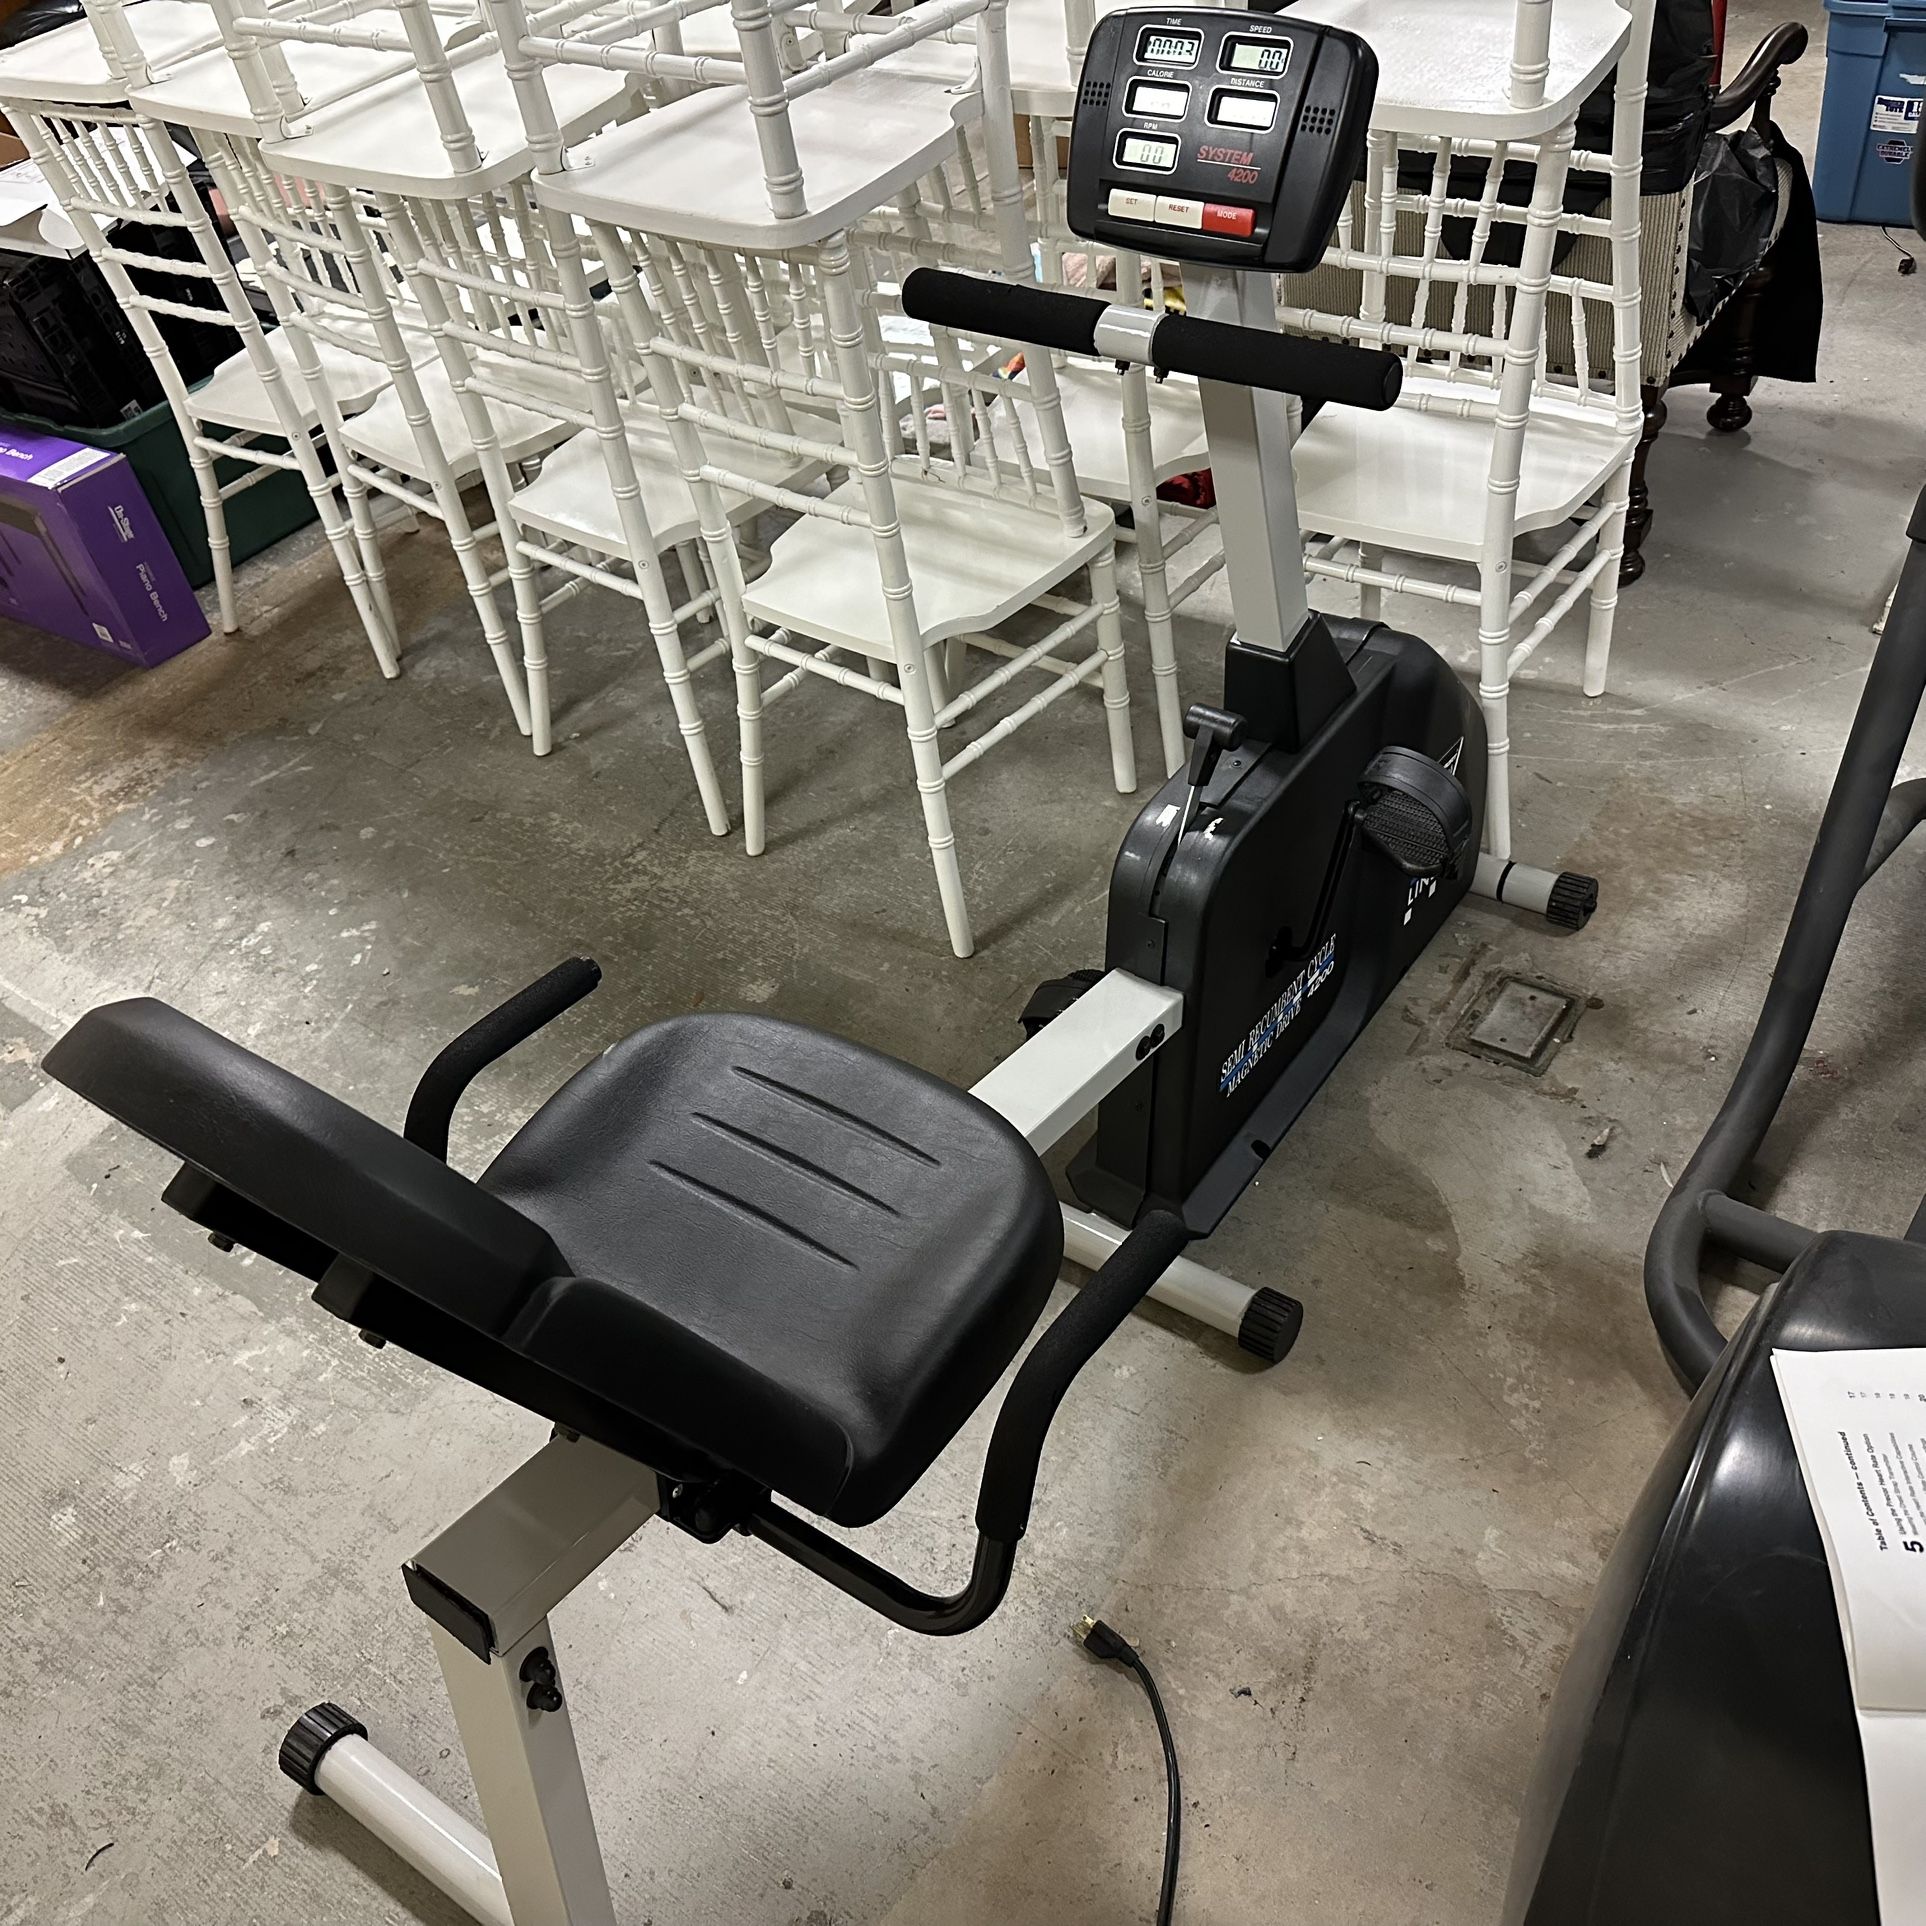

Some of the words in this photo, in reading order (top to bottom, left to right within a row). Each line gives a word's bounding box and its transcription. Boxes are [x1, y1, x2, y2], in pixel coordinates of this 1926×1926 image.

[1166, 17, 1182, 26] TIME
[1249, 24, 1273, 34] SPEED
[1147, 69, 1174, 79] CALORIE
[1230, 77, 1265, 88] DISTANCE
[1143, 122, 1158, 130] RPM
[1140, 143, 1165, 164] 00
[1197, 145, 1254, 166] SYSTEM
[1227, 167, 1259, 184] 4200
[1125, 197, 1139, 206] SET
[1168, 203, 1190, 213] RESET
[1216, 210, 1237, 220] MODE
[136, 563, 152, 591] Piano
[150, 591, 168, 622] Bench
[1407, 876, 1437, 906] LIN
[1221, 1039, 1246, 1083] SEMI
[1248, 969, 1305, 1049] RECUMBENT
[1306, 933, 1337, 980] CYCLE
[1226, 1031, 1274, 1098] MAGNETIC
[1275, 997, 1302, 1040] DRIVE
[1306, 960, 1335, 998] 4200
[1837, 1431, 1858, 1470] continued
[1863, 1433, 1875, 1454] Option
[1870, 1454, 1880, 1468] Rate
[1875, 1469, 1885, 1486] Heart
[1856, 1481, 1875, 1517] Contents
[1882, 1487, 1894, 1507] Precor
[1868, 1517, 1879, 1526] of
[1895, 1517, 1907, 1535] Using
[1874, 1528, 1888, 1551] Table
[1902, 1540, 1924, 1553] 5
